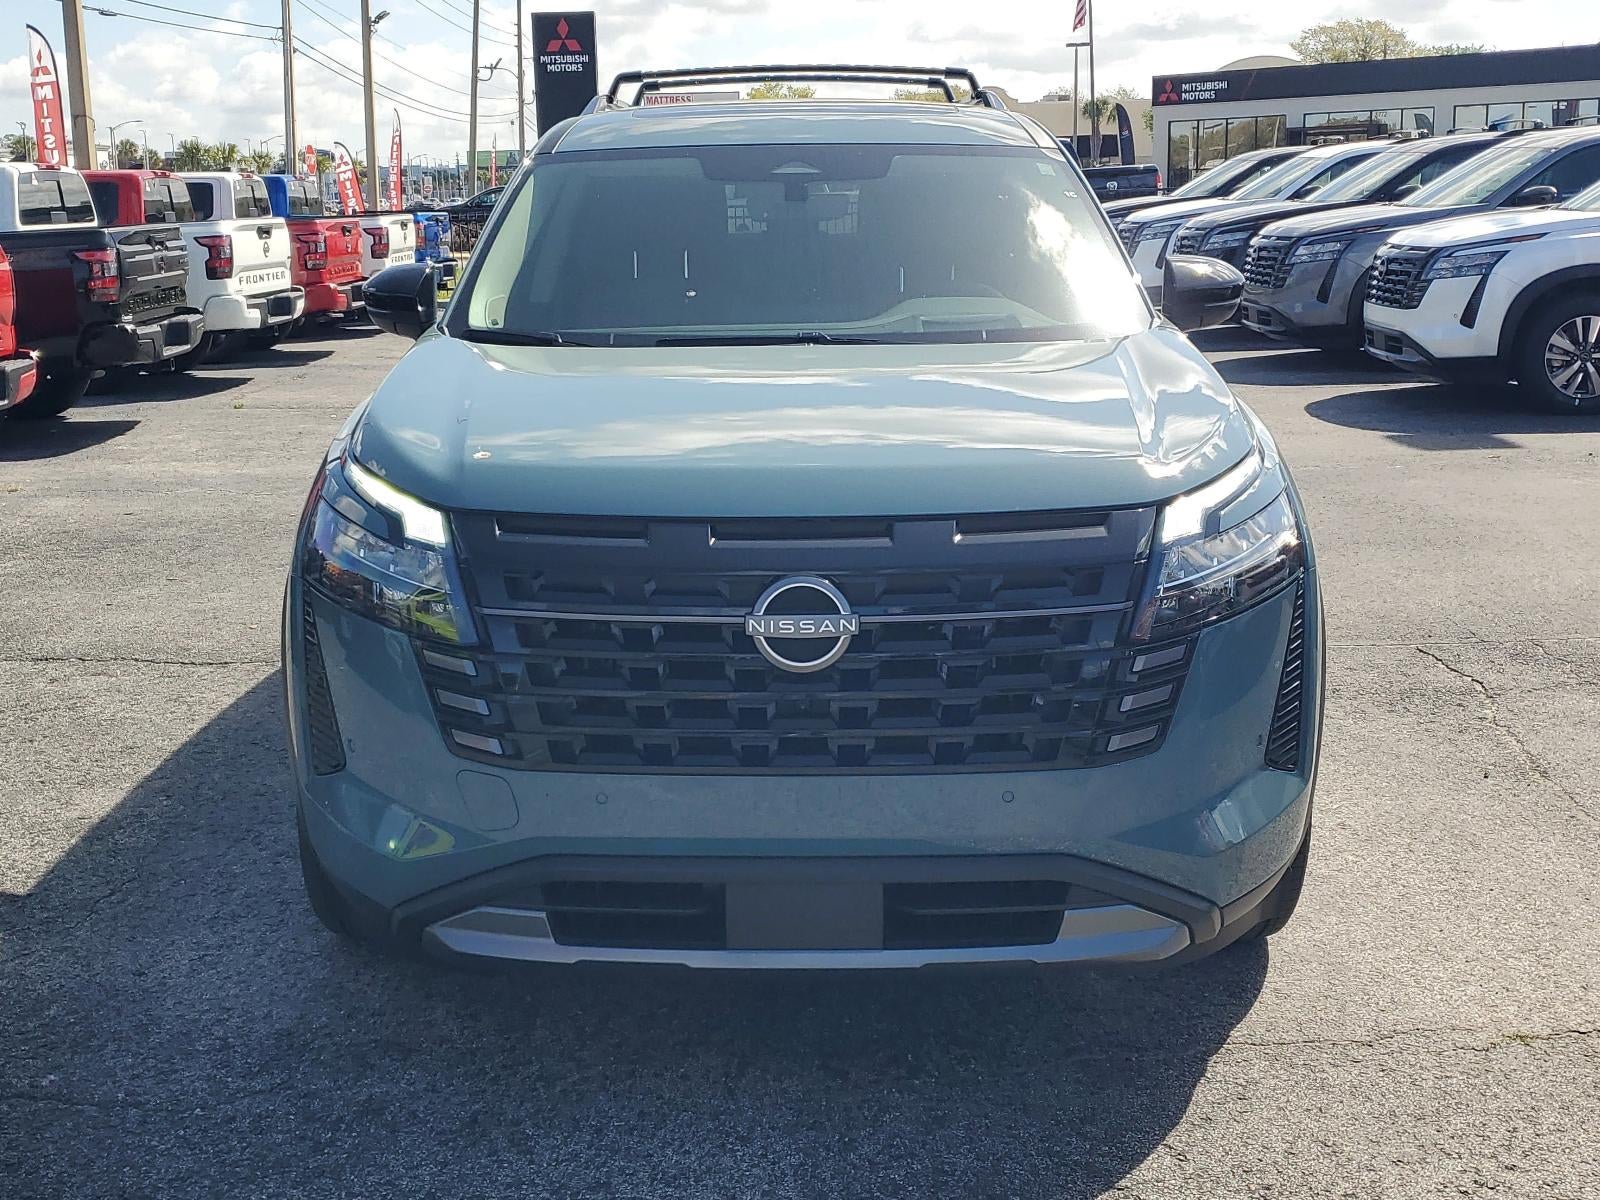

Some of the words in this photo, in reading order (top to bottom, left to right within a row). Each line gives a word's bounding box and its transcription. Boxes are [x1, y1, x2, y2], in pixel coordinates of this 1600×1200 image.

[540, 54, 589, 64] MITSUBISHI
[547, 63, 583, 73] MOTORS
[1181, 80, 1228, 92] MITSUBISHI
[645, 95, 693, 107] MATTRESS
[1181, 91, 1216, 101] MOTORS
[239, 271, 286, 286] FRONTIER
[748, 618, 856, 633] NISSAN
